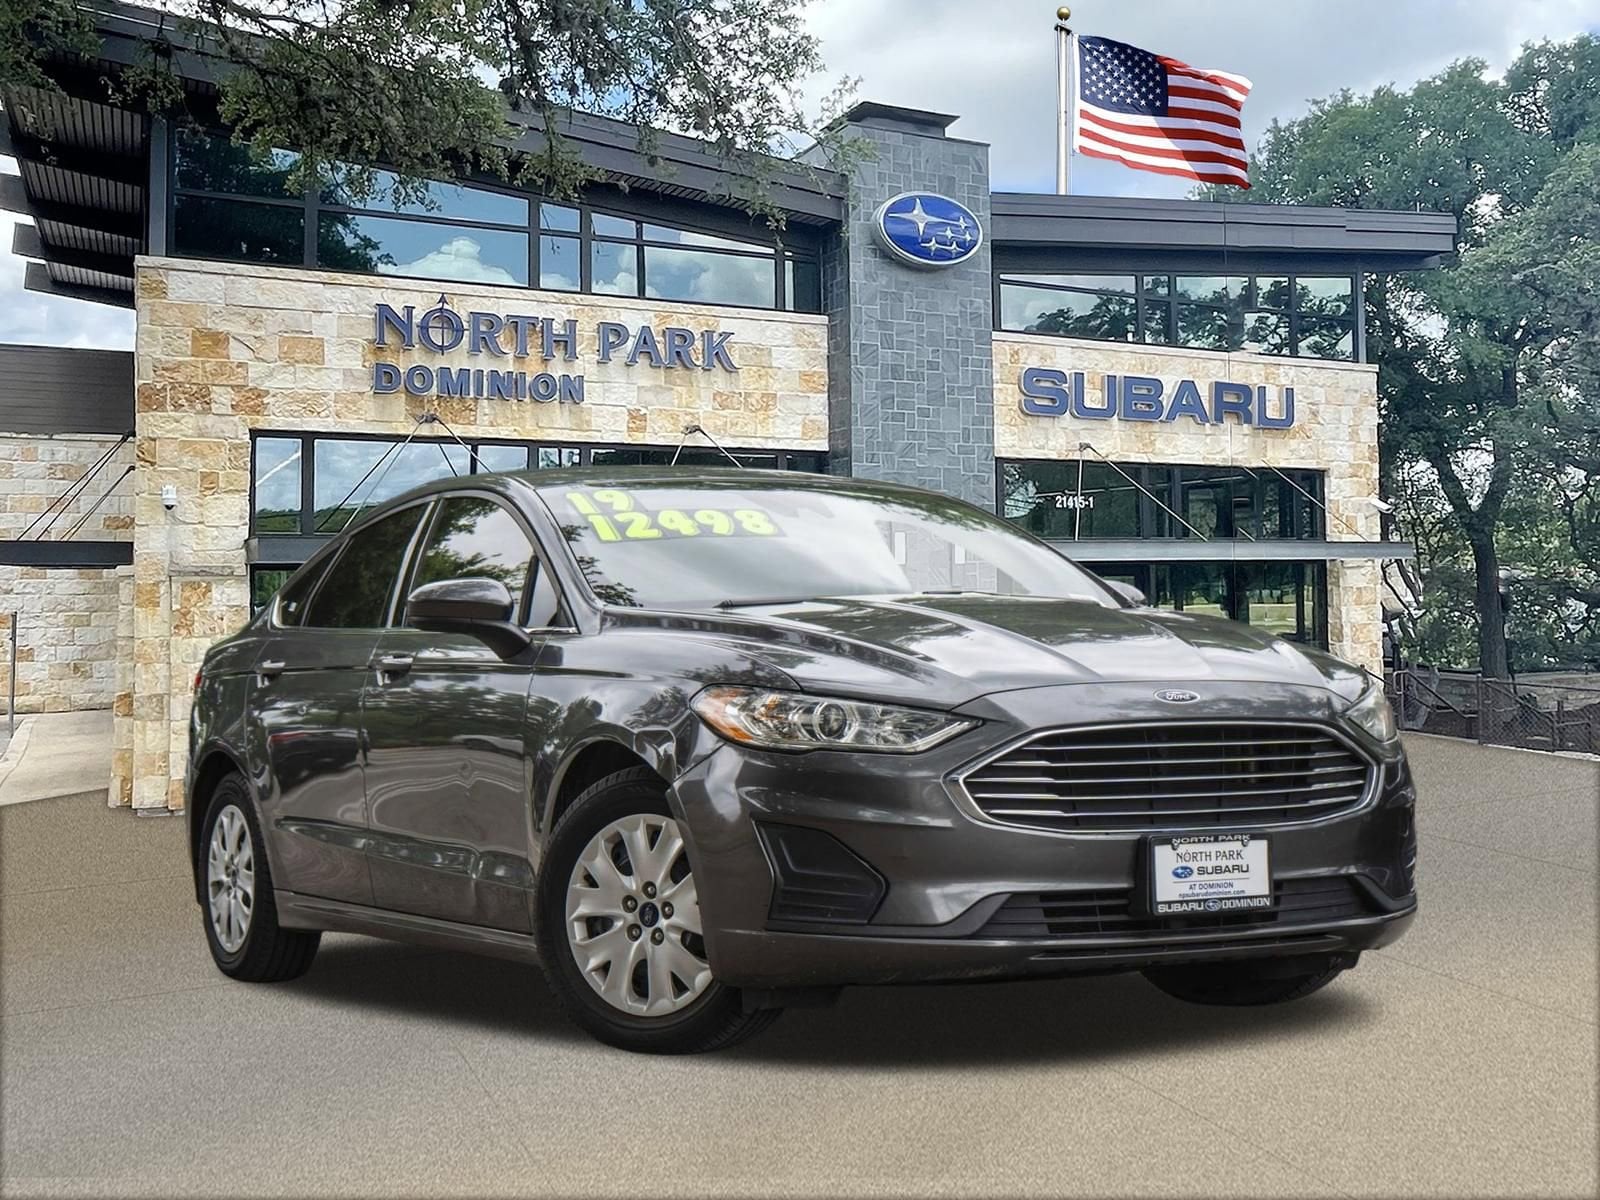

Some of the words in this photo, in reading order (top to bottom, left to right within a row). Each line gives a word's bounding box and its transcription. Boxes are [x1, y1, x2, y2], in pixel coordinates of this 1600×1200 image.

[374, 294, 579, 361] NORTH
[596, 321, 742, 373] PARK
[373, 362, 585, 405] DOMINION
[1019, 367, 1295, 430] SUBARU
[566, 489, 633, 516] 19
[588, 509, 779, 542] 12498
[1176, 850, 1212, 863] NORTH
[1215, 849, 1244, 860] PARK
[1197, 864, 1249, 875] SUBARU
[1178, 889, 1246, 899] npsubarudominion.com
[1198, 882, 1234, 890] DOMINION
[1157, 902, 1204, 913] SUBARU
[1221, 897, 1270, 908] DOMINION
